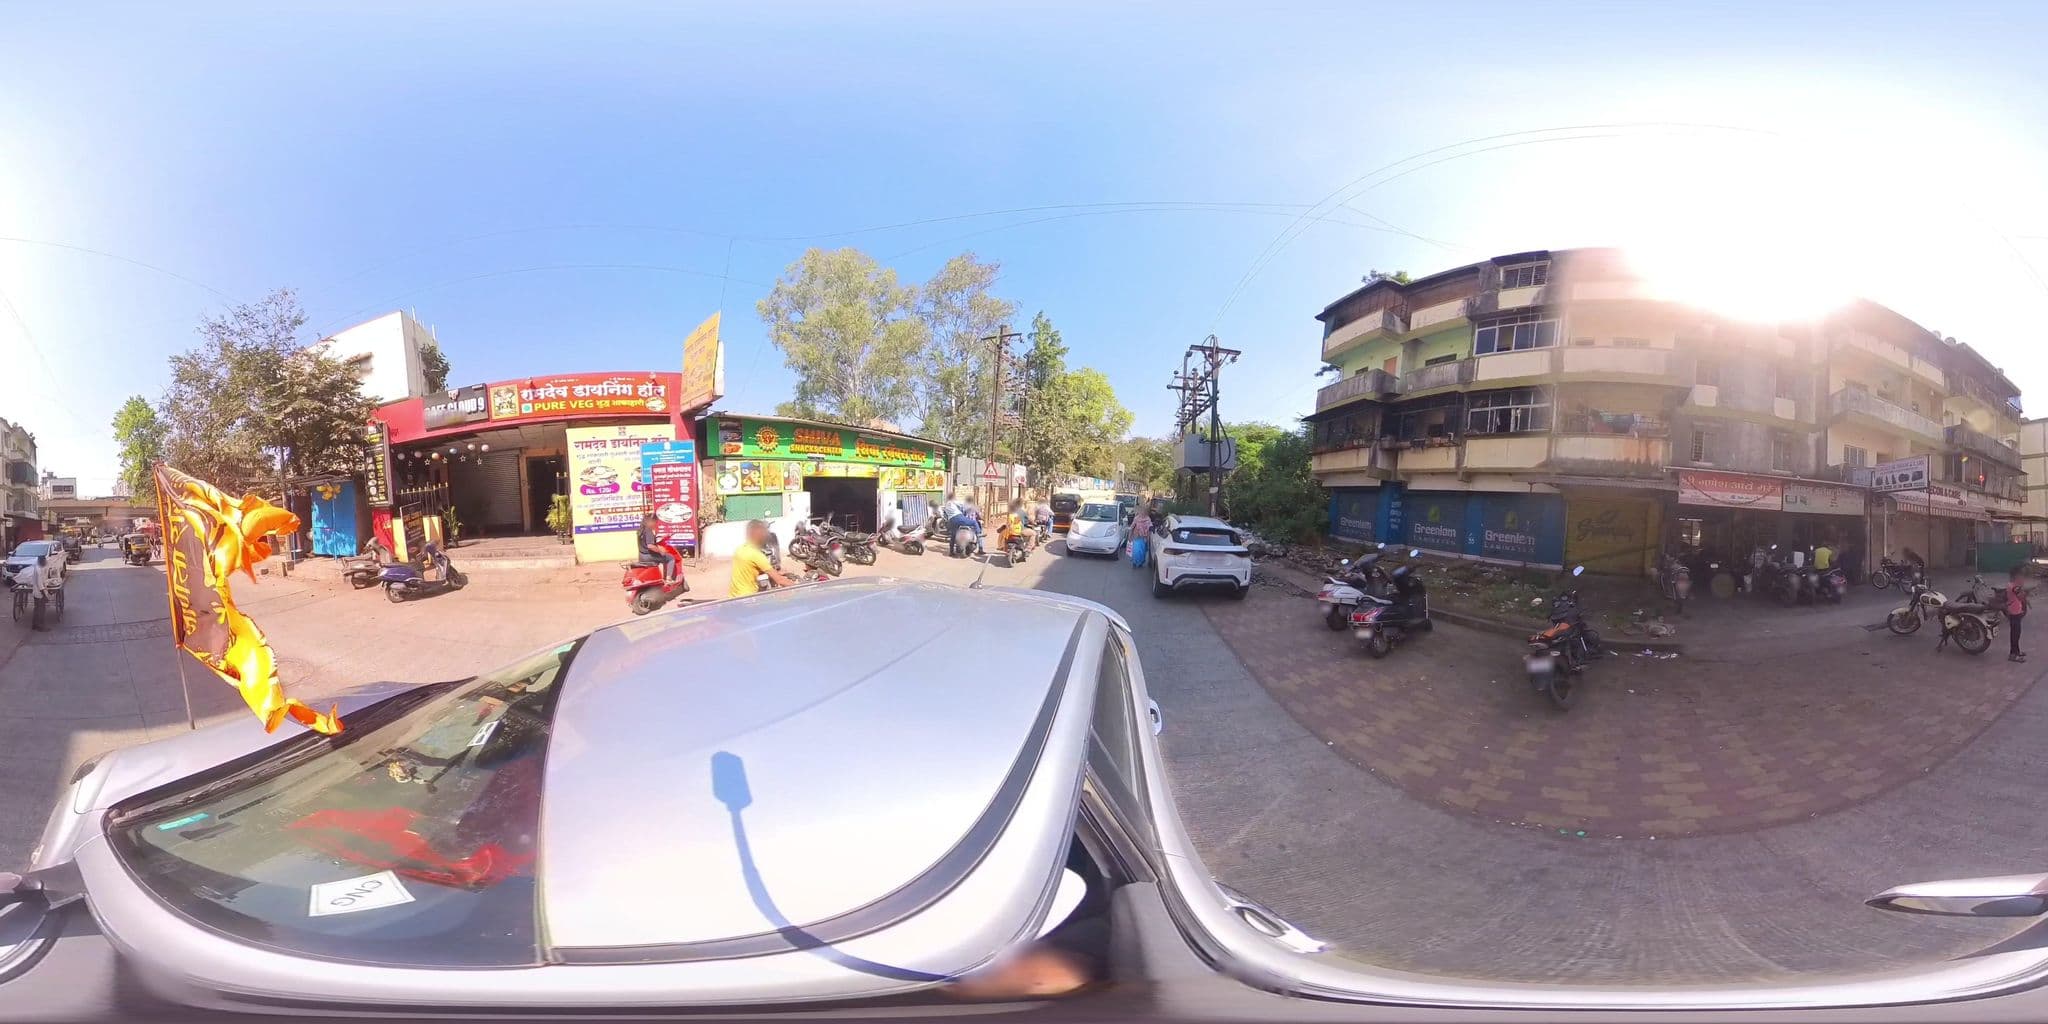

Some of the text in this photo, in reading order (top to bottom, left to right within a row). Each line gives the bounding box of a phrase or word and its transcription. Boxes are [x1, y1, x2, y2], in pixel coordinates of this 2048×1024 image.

[520, 384, 568, 401] रामदेव
[572, 380, 633, 397] डायनिंग
[637, 382, 666, 398] हॉल
[478, 397, 485, 412] 9
[534, 400, 566, 412] PURE
[570, 400, 594, 409] VEG
[573, 437, 607, 451] रामदेव
[818, 446, 843, 457] CENTER
[1340, 517, 1372, 530] Greenlam
[1414, 523, 1457, 538] Greenlam
[330, 879, 383, 906] CNG
